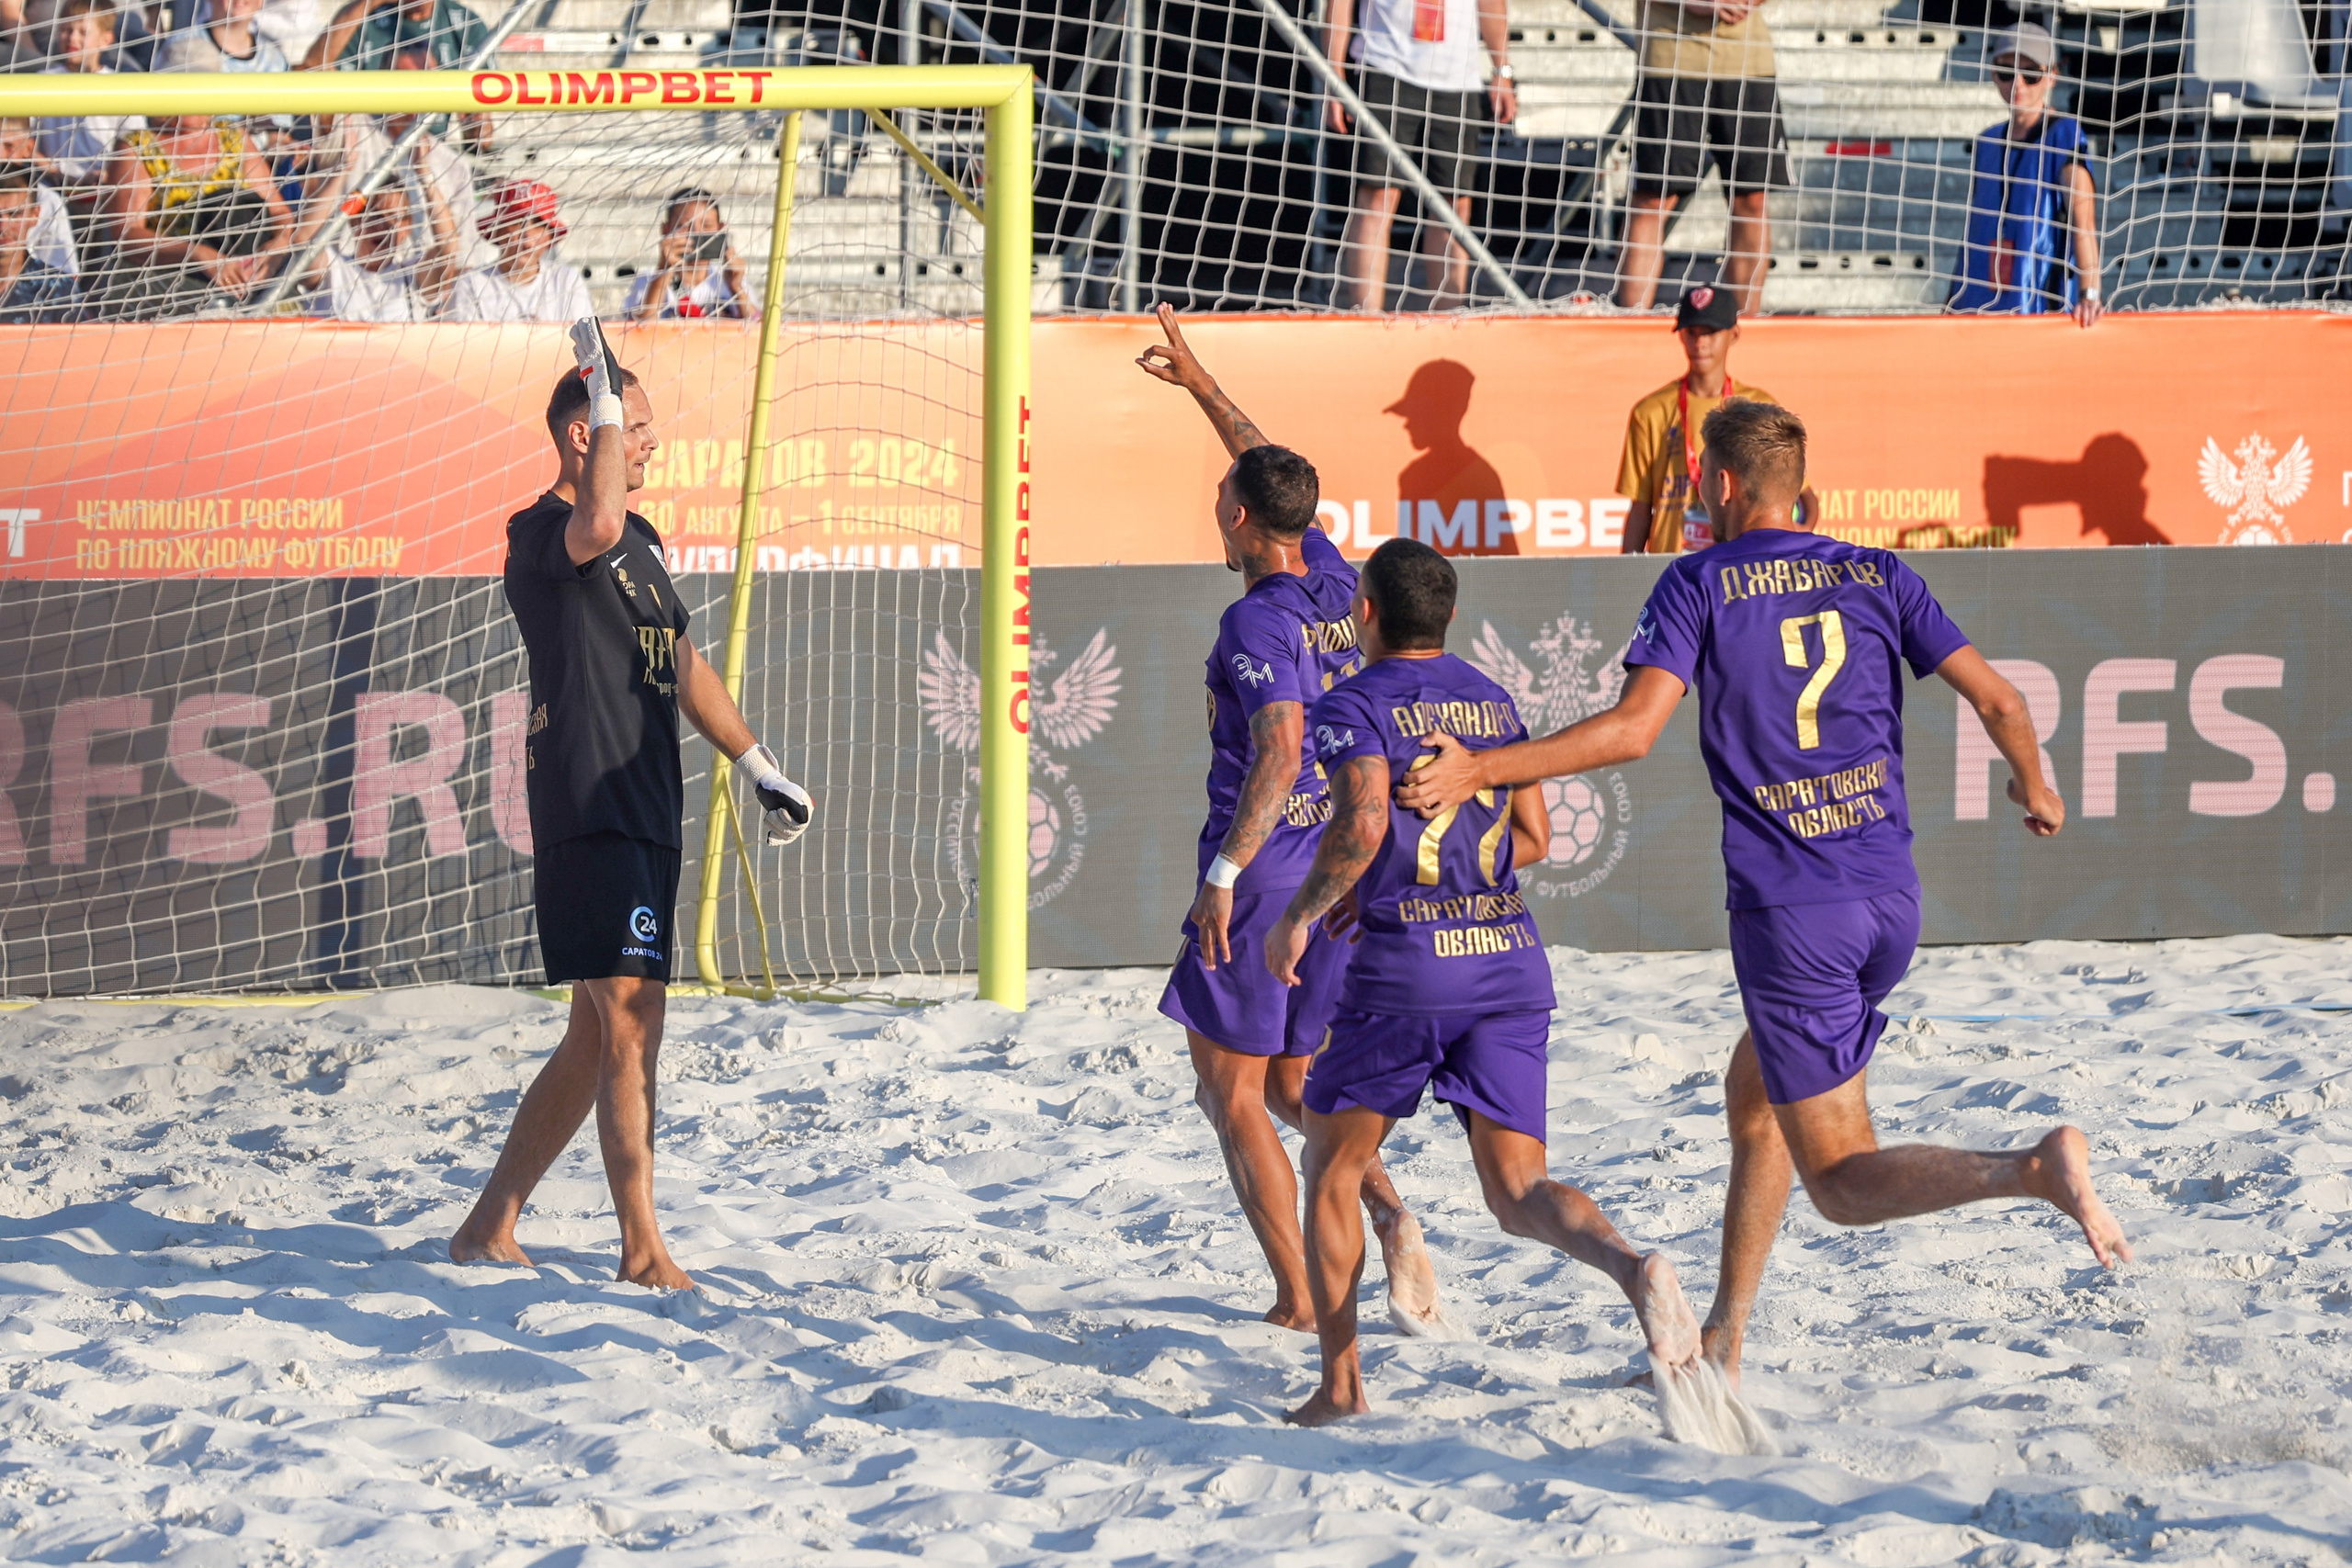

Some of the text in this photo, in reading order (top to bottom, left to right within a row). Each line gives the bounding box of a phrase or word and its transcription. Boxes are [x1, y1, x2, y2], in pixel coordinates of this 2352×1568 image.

[471, 72, 772, 104] OLIMPBET
[643, 438, 960, 490] САРАОВ 2024
[76, 499, 345, 530] ЧЕМПИОНАТ РОССИИ
[684, 506, 784, 536] АВГУТА
[842, 505, 960, 536] СЕНТЯБРЯ
[1864, 489, 1960, 520] РОССИИ
[1314, 498, 1632, 550] OLIMPBE
[76, 536, 403, 570] ПО ПЛЯЖНОМУ ФУТБОЛУ
[1720, 558, 1884, 604] ДЖАБАРОВ
[1779, 609, 1847, 750] 7
[1787, 793, 1885, 839] ОБЛАСТЬ
[622, 947, 655, 958] САРАТОВ
[1433, 922, 1536, 958] ОБЛАСТЬ
